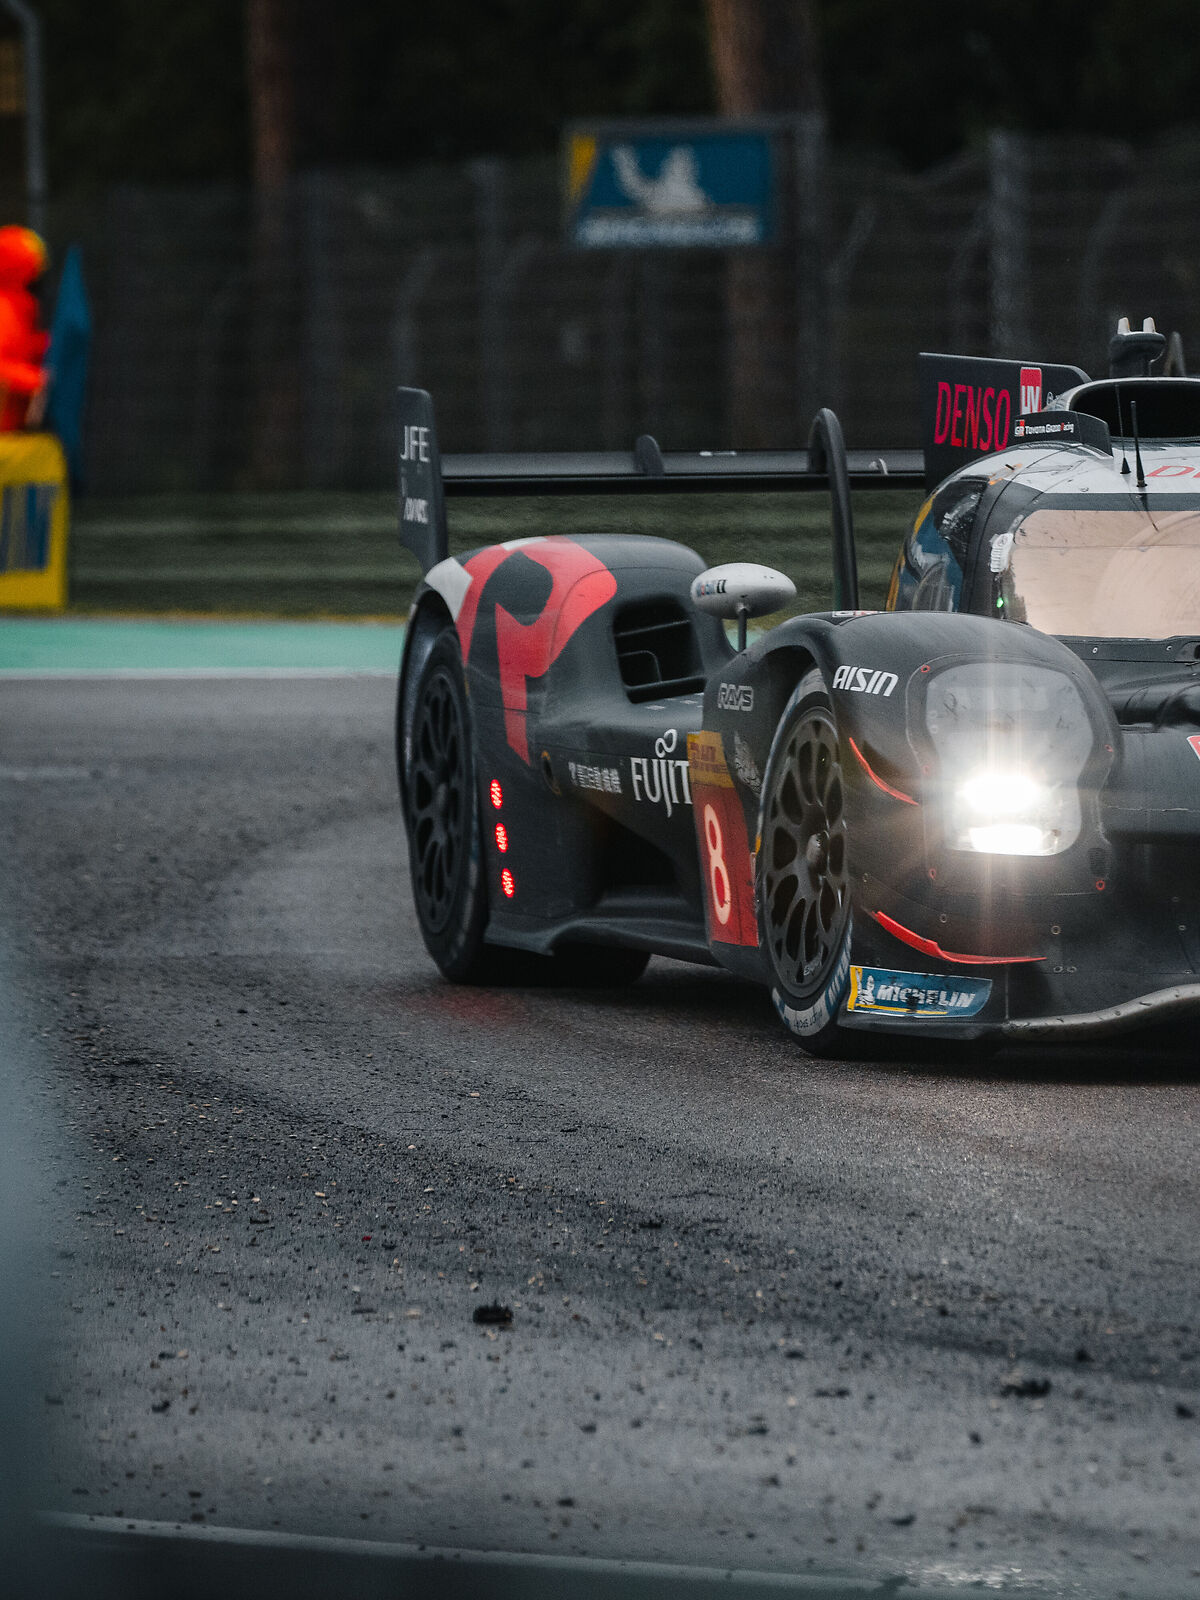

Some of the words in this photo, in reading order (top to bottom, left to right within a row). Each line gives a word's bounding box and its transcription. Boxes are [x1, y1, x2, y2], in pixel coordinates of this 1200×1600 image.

[933, 381, 1011, 452] DENSO
[400, 425, 430, 463] JFE
[718, 682, 754, 712] RAYS
[832, 665, 899, 697] AISIN
[630, 755, 693, 818] FUJIT
[704, 803, 731, 925] 8
[876, 984, 976, 1008] MICHELIN
